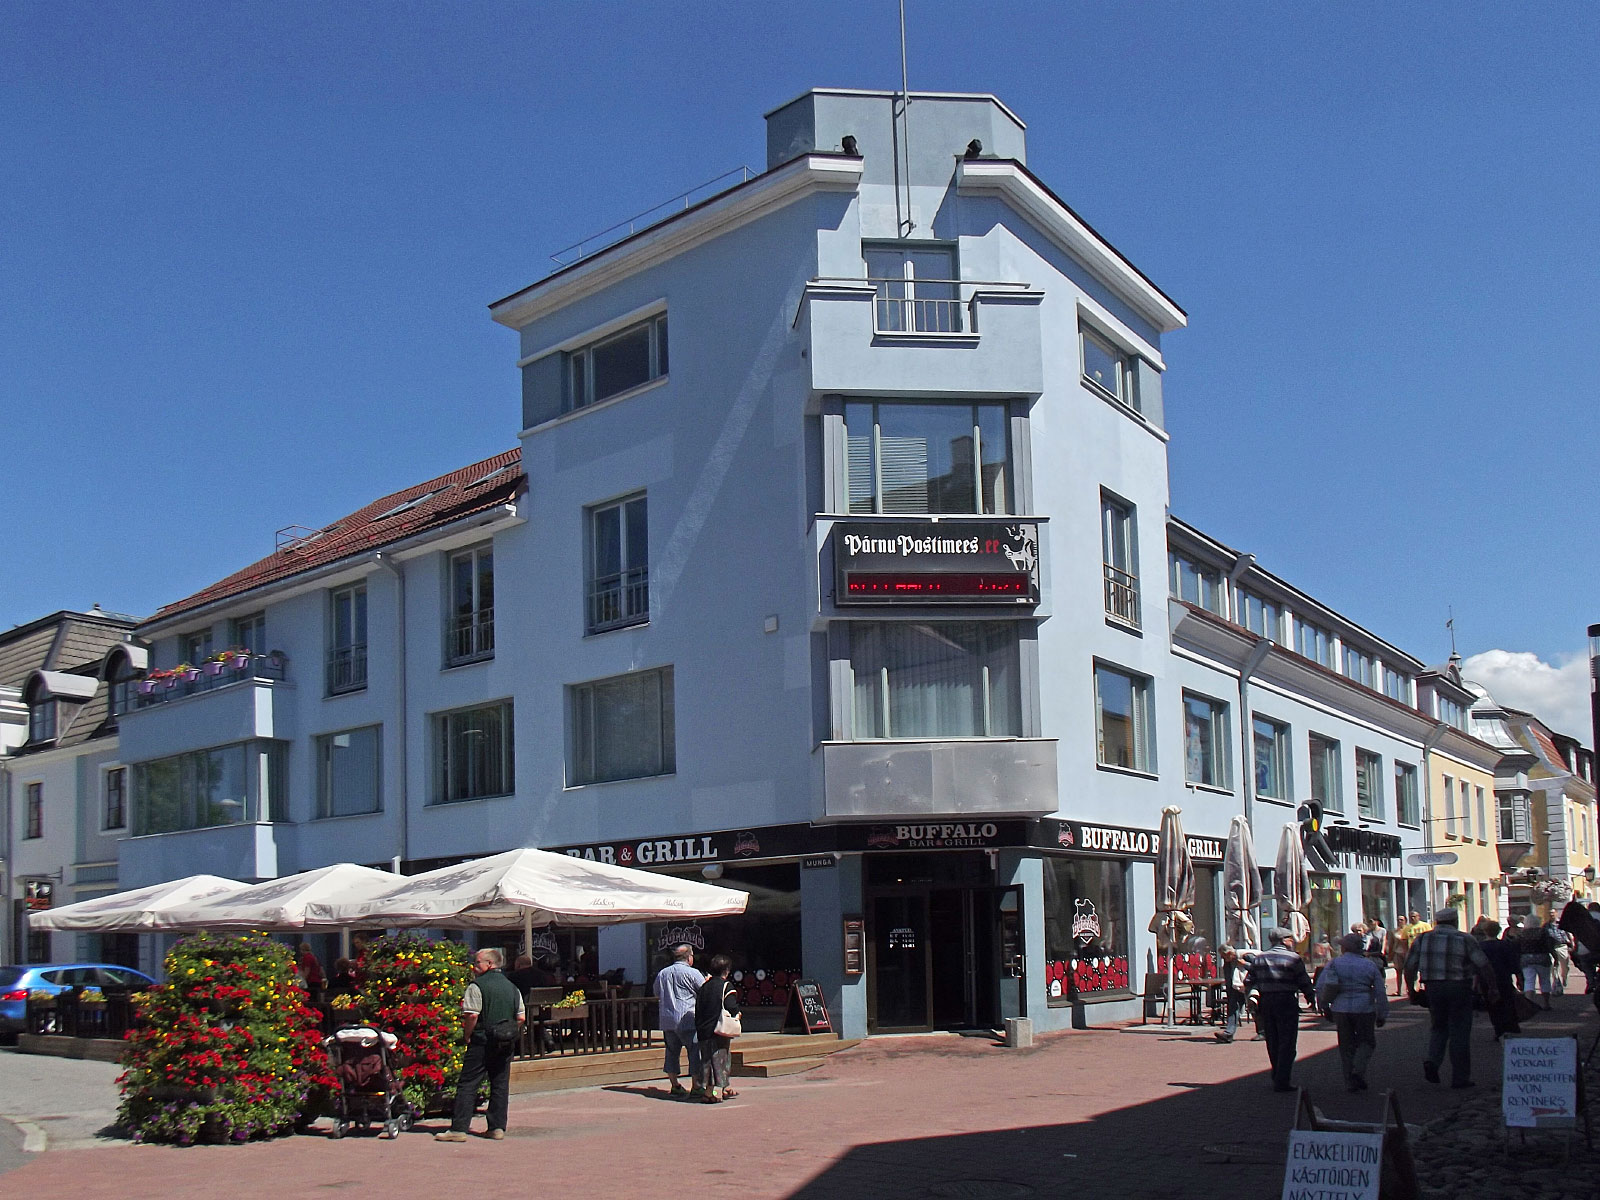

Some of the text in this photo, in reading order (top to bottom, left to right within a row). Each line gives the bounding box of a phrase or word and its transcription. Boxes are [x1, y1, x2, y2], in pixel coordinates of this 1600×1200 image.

[895, 823, 998, 840] BUFFALO
[621, 847, 633, 861] &
[636, 836, 718, 864] GRILL
[909, 839, 935, 847] BAR
[944, 838, 986, 847] GRILL
[1081, 826, 1150, 856] BUFFALO
[1188, 837, 1223, 859] GRILL
[1518, 1083, 1542, 1094] VON
